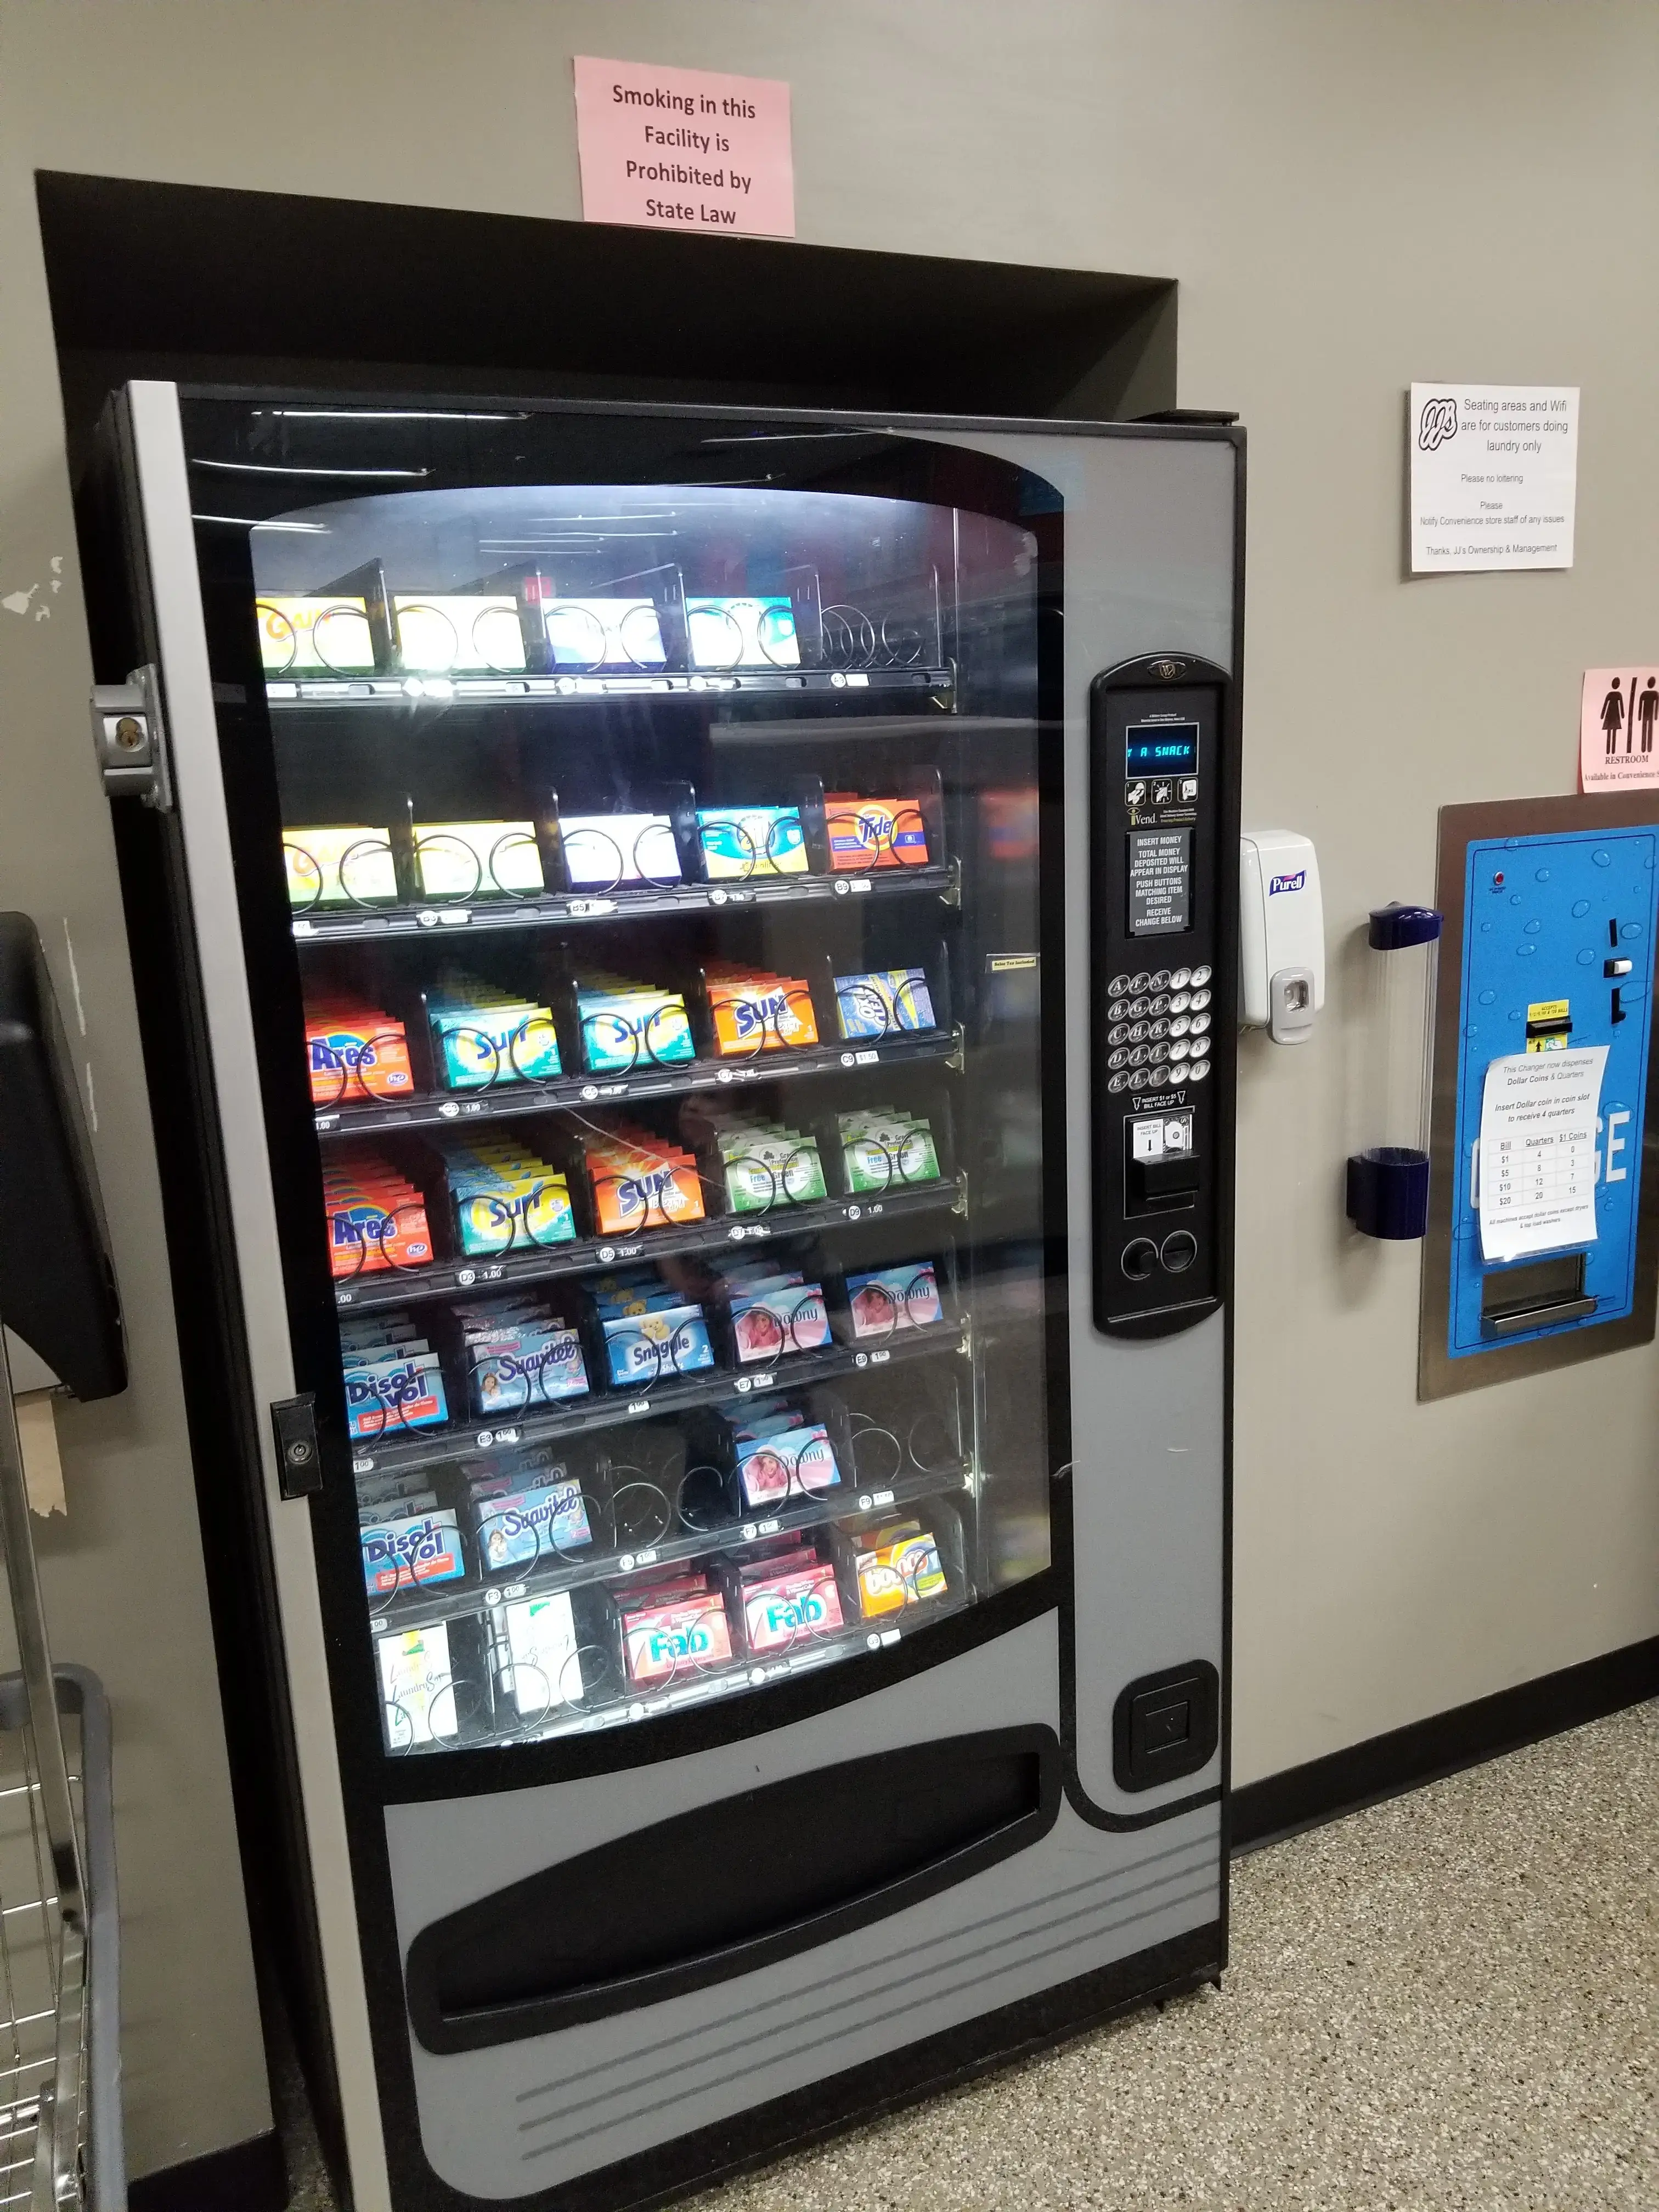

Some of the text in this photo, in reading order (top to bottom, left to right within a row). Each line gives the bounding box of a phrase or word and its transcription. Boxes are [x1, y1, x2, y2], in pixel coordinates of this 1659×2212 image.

[613, 84, 755, 119] Smoking in this
[645, 126, 729, 154] Facility is
[626, 160, 752, 194] Prohibited by
[646, 199, 736, 224] State Law
[1464, 398, 1567, 413] Seating areas and Wifi
[1461, 419, 1568, 434] are for customers doing
[1487, 439, 1542, 454] laundry only
[1461, 474, 1484, 483] Please
[1480, 501, 1503, 509] Please
[1420, 515, 1565, 527] Notify Convenience store staff of any issues
[1468, 545, 1503, 555] Ownership
[1513, 544, 1557, 554] Management
[1141, 745, 1190, 757] A SNACK
[1605, 755, 1649, 764] RESTROOM
[1584, 773, 1609, 781] Available
[859, 815, 893, 843] Tide
[1137, 836, 1182, 847] INSERT MONEY
[1138, 848, 1181, 859] TOTAL MONEY
[1135, 858, 1167, 867] DEPOSITED
[1130, 868, 1154, 877] APPEAR
[1163, 865, 1188, 874] DISPLAY
[1136, 877, 1182, 888] PUSH BUTTONS
[1272, 875, 1303, 891] Purell
[1135, 885, 1183, 898] MATCHING ITEM
[1146, 896, 1172, 905] DESIRED
[1147, 907, 1171, 917] RECEIVE
[1135, 915, 1182, 927] CHANGE BELOW
[734, 994, 788, 1039] SUN
[475, 1015, 529, 1060] Surf
[1561, 1058, 1594, 1067] dispenses
[1507, 1077, 1528, 1085] Dollar
[1557, 1071, 1584, 1080] Quarters
[1495, 1103, 1515, 1111] Insert
[1516, 1101, 1536, 1109] Dollar
[1516, 1112, 1541, 1121] receive
[1547, 1108, 1575, 1119] quarters
[1500, 1132, 1587, 1150] Bill Quarters $1 Coins
[867, 1156, 882, 1164] Free
[1502, 1155, 1509, 1164] $1
[617, 1169, 674, 1218] SUN
[1499, 1183, 1511, 1192] $10
[489, 1181, 544, 1227] Surf
[1499, 1197, 1511, 1205] $20
[867, 1204, 883, 1214] 1.00
[887, 1286, 930, 1304] Downy
[774, 1308, 817, 1327] Downy
[633, 1334, 690, 1365] Snuggle
[740, 1380, 749, 1389] E7
[479, 1434, 492, 1443] E3
[779, 1449, 824, 1469] Downy
[861, 1498, 870, 1506] F9
[746, 1527, 754, 1536] F7
[766, 1596, 822, 1633] Fab
[650, 1626, 709, 1662] Fab
